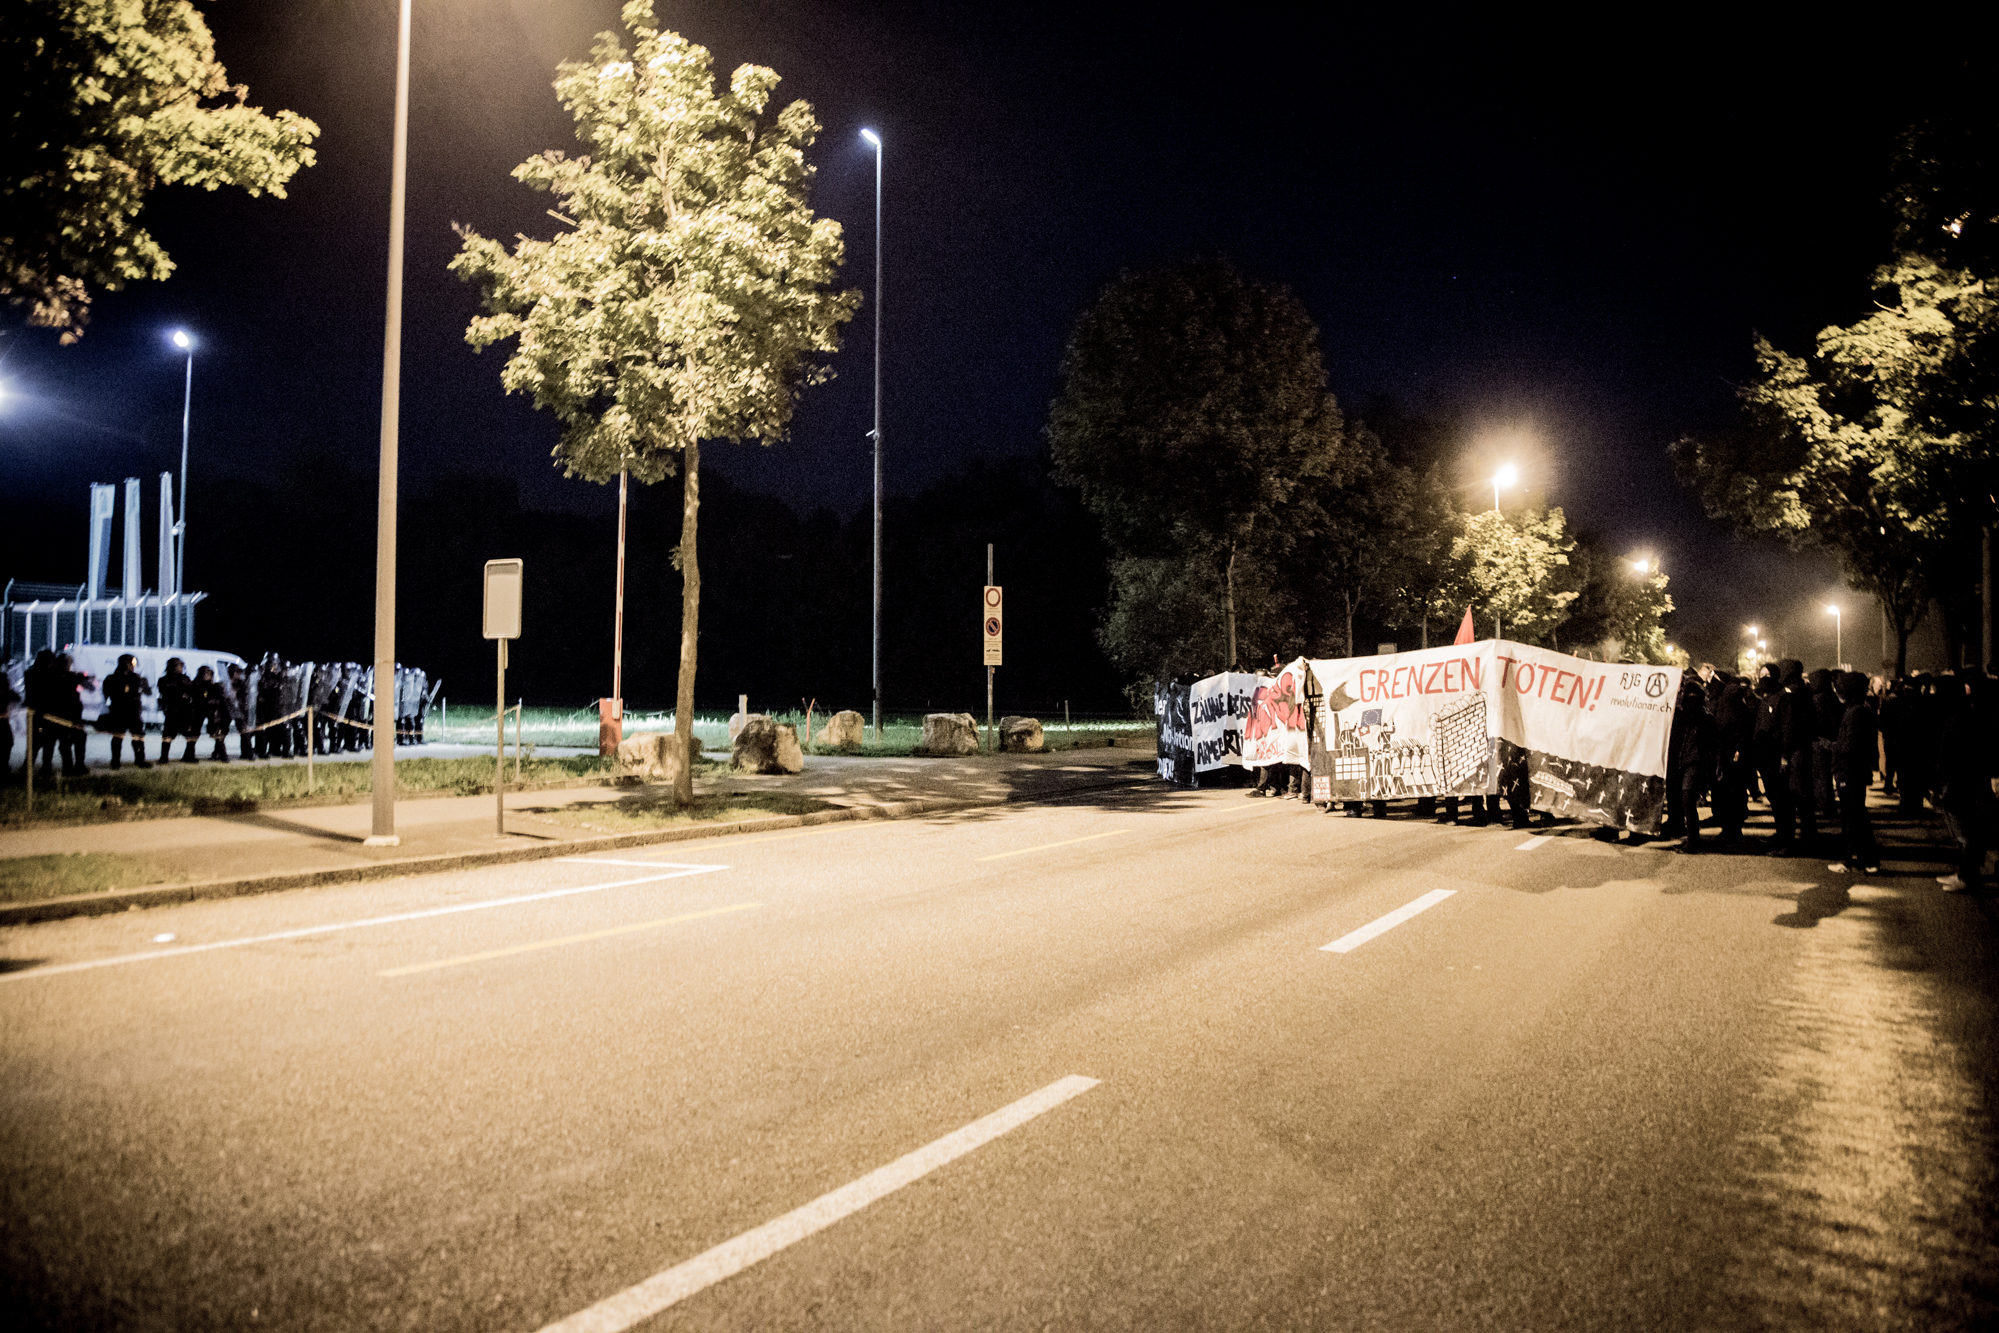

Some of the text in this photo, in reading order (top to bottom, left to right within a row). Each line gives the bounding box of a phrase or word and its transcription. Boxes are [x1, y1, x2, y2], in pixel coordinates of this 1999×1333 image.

[1360, 656, 1606, 712] GRENZEN TÖTEN!
[1191, 692, 1227, 724] ZÄUNE
